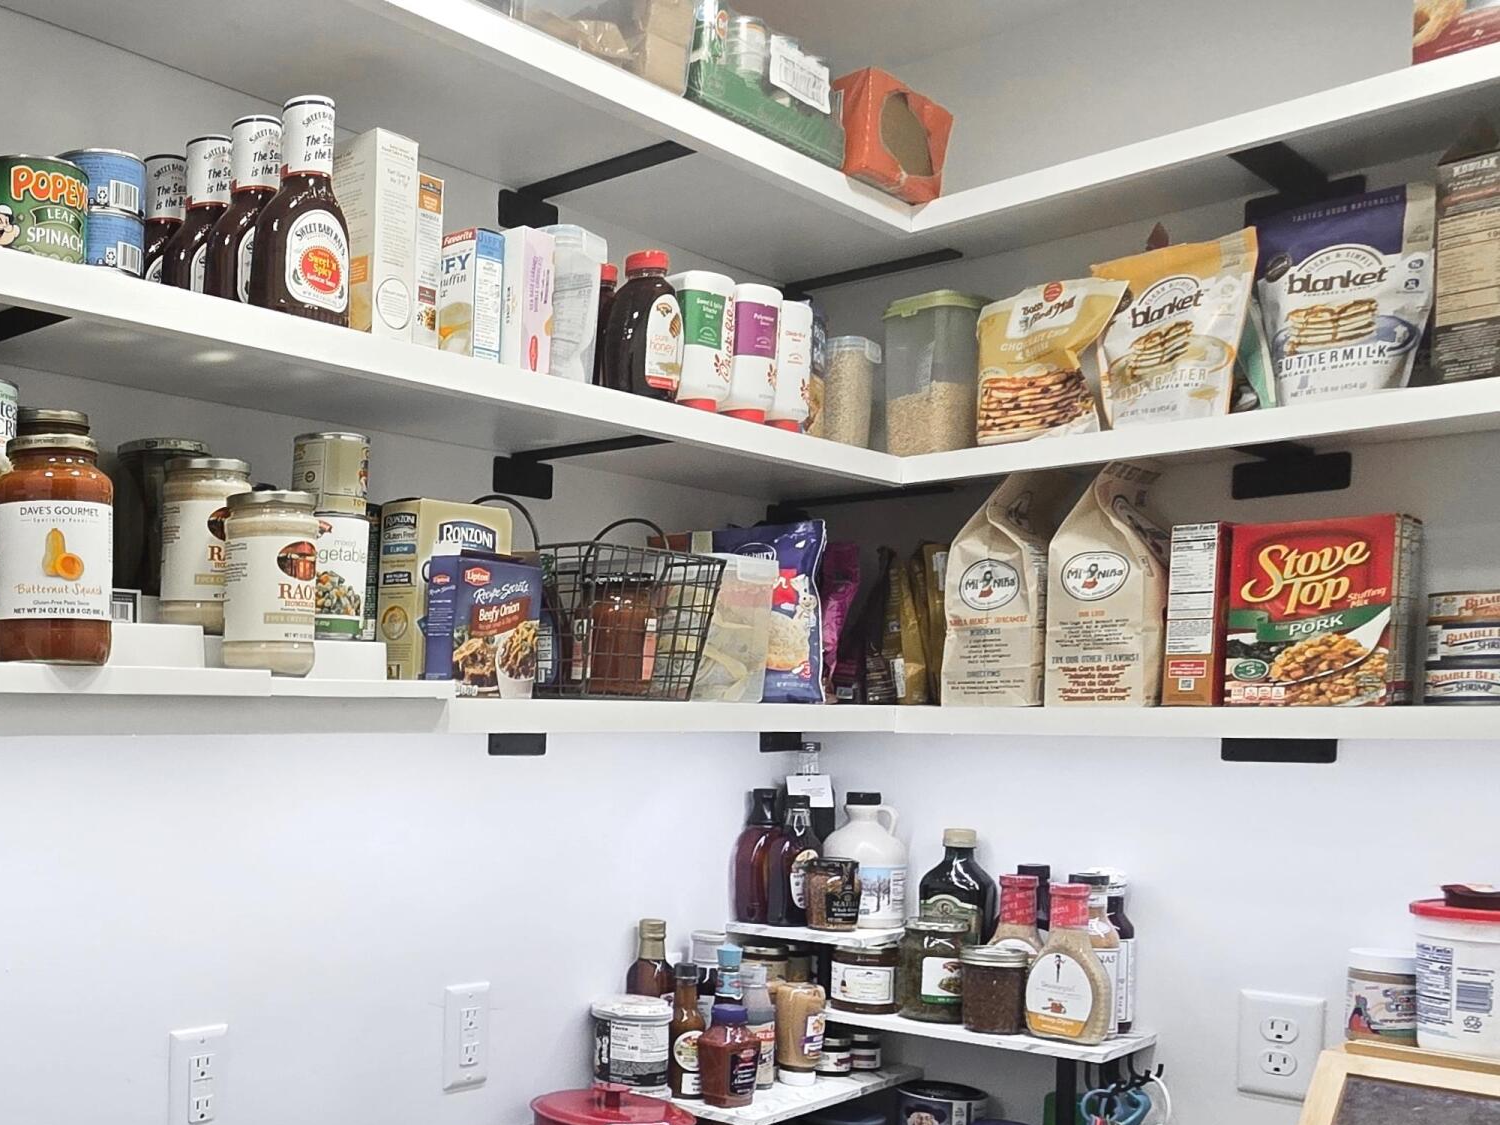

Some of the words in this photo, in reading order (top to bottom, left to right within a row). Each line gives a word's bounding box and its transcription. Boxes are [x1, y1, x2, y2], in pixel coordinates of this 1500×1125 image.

[306, 136, 320, 147] The
[304, 152, 312, 162] is
[315, 151, 327, 160] the
[46, 207, 75, 224] LEAF
[26, 226, 83, 253] SPINACH
[295, 223, 316, 240] SWEET
[443, 230, 474, 247] Favorite
[1287, 266, 1388, 295] blanket
[1131, 294, 1203, 328] blanket
[1278, 345, 1387, 373] BUTTERMILK
[19, 506, 52, 516] DAVE'S
[55, 505, 99, 517] GOURMET
[443, 524, 493, 548] RONZONI
[467, 572, 490, 581] Lipton
[1066, 569, 1082, 579] Mi
[1241, 541, 1370, 603] Stove
[16, 584, 67, 595] Butternut
[474, 588, 501, 604] Recipe
[502, 581, 529, 599] Secrets
[1284, 576, 1349, 615] Top
[1346, 587, 1386, 602] Stuffing
[479, 607, 499, 622] Beefy
[500, 603, 520, 616] Onion
[1289, 614, 1344, 636] PORK
[1446, 630, 1493, 647] BUMBLE
